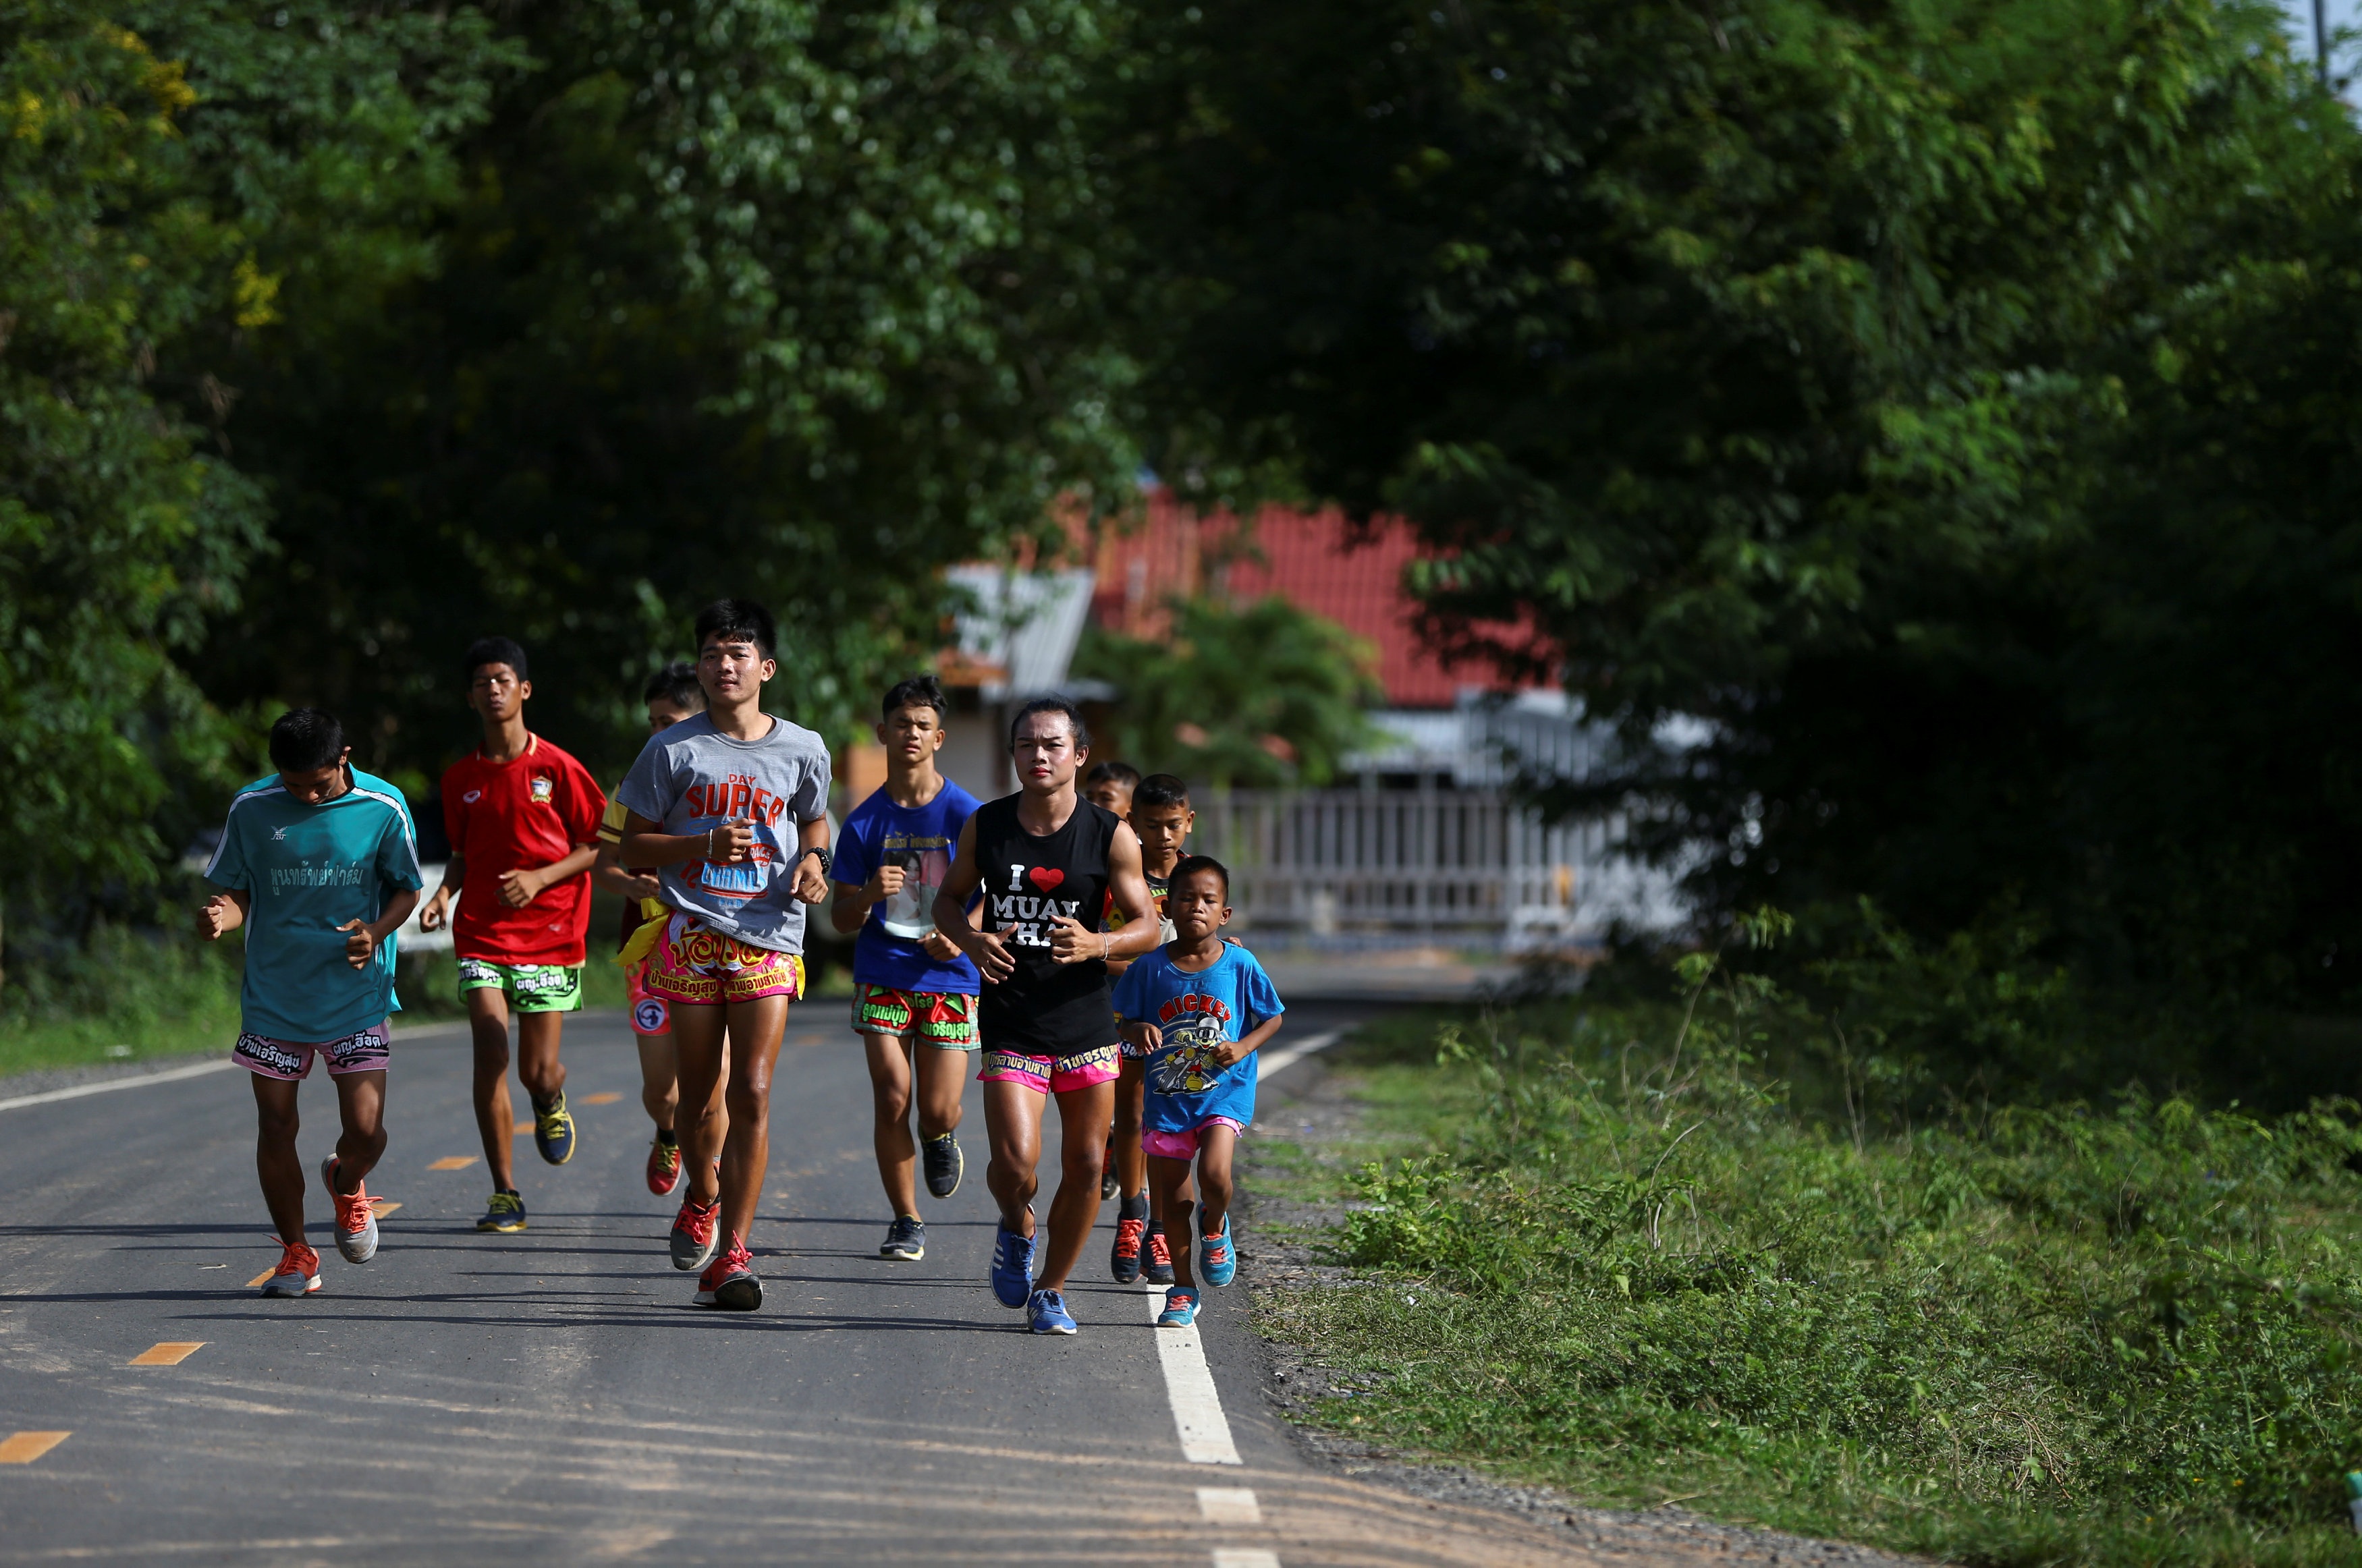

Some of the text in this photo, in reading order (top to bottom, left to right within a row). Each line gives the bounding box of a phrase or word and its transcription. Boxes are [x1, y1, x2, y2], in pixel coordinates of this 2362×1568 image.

[729, 774, 756, 785] DAY
[686, 783, 784, 830] SUPER
[271, 860, 364, 896] พูนทรัพย์ฟาร์ม
[1008, 864, 1025, 891] I
[992, 894, 1080, 920] MUAY
[996, 921, 1069, 947] THA
[1159, 993, 1232, 1024] MICKEY
[238, 1033, 300, 1073] บ้านเจริญสุข
